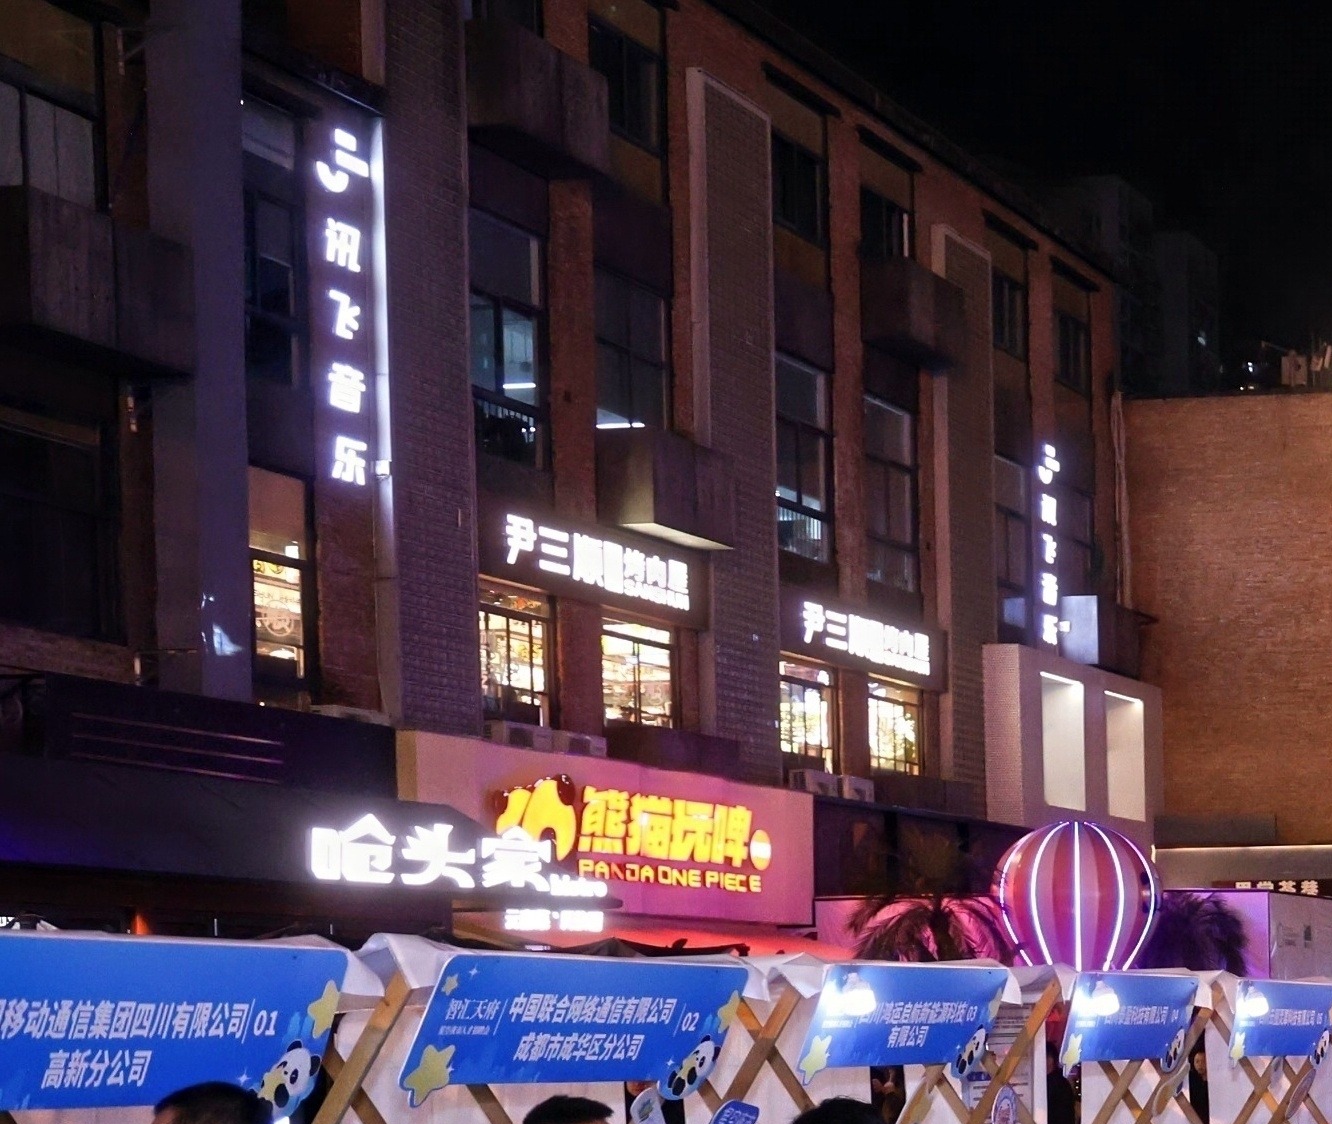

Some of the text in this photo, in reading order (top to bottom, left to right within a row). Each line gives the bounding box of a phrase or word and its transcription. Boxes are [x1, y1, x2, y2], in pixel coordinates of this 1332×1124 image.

[326, 217, 367, 487] 讯飞音乐
[579, 785, 755, 868] 熊猫玩啤
[657, 865, 702, 888] ONE
[705, 869, 762, 893] PIECE
[0, 998, 279, 1040] 移动通信集团四川有限公司 01
[508, 992, 678, 1024] 中国联合网络通信有限公司
[681, 1012, 700, 1032] 02
[513, 1031, 645, 1063] 成都市成华区分公司
[886, 1025, 930, 1049] 有限公司
[41, 1049, 153, 1090] 高新分公司
